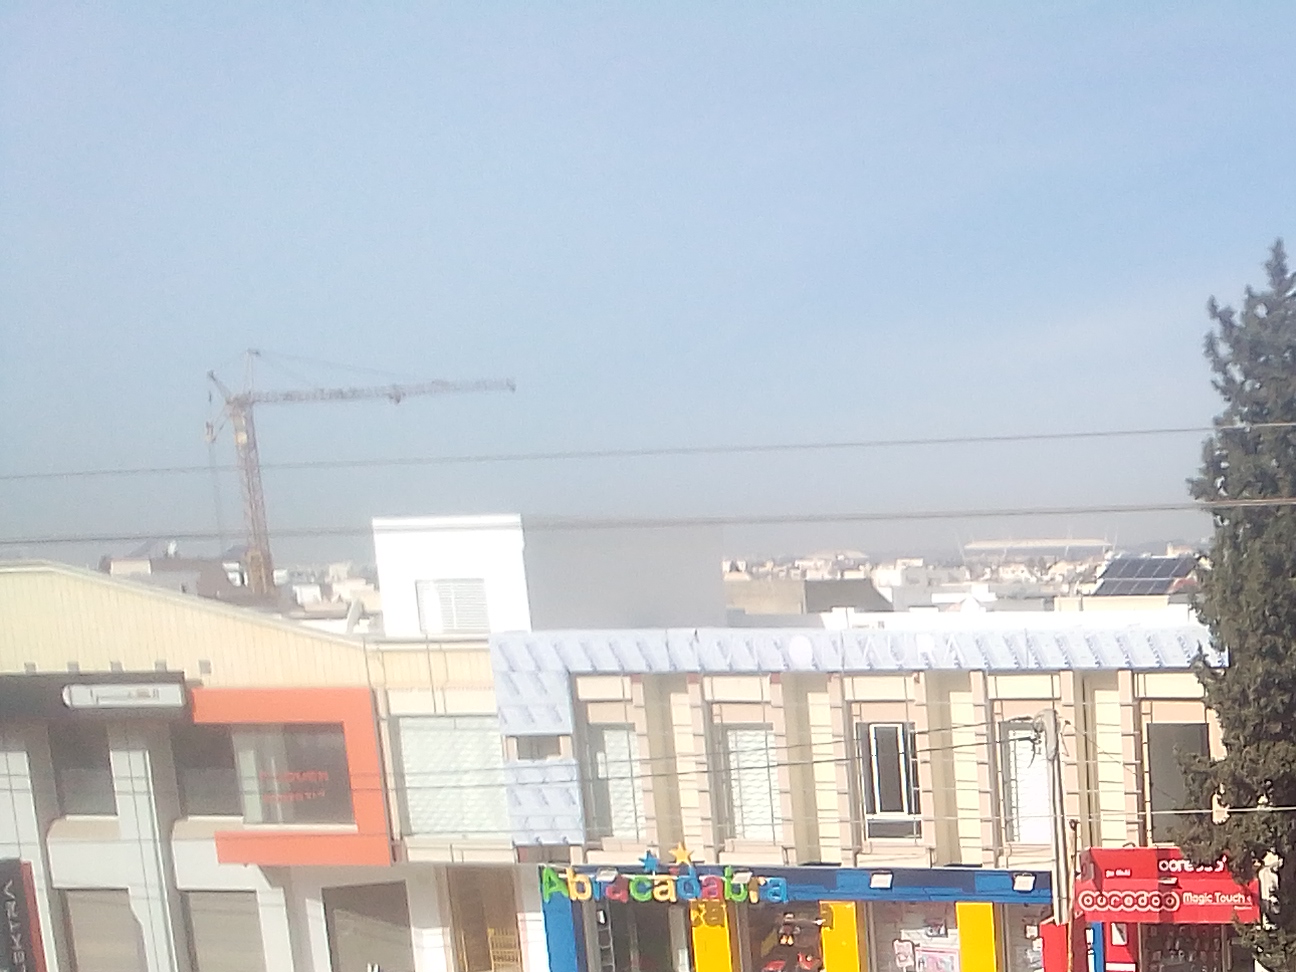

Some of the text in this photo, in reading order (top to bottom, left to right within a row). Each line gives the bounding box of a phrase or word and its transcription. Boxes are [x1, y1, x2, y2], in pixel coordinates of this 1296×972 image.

[1078, 890, 1180, 912] ooredoo
[1182, 891, 1246, 905] Magic Touch
